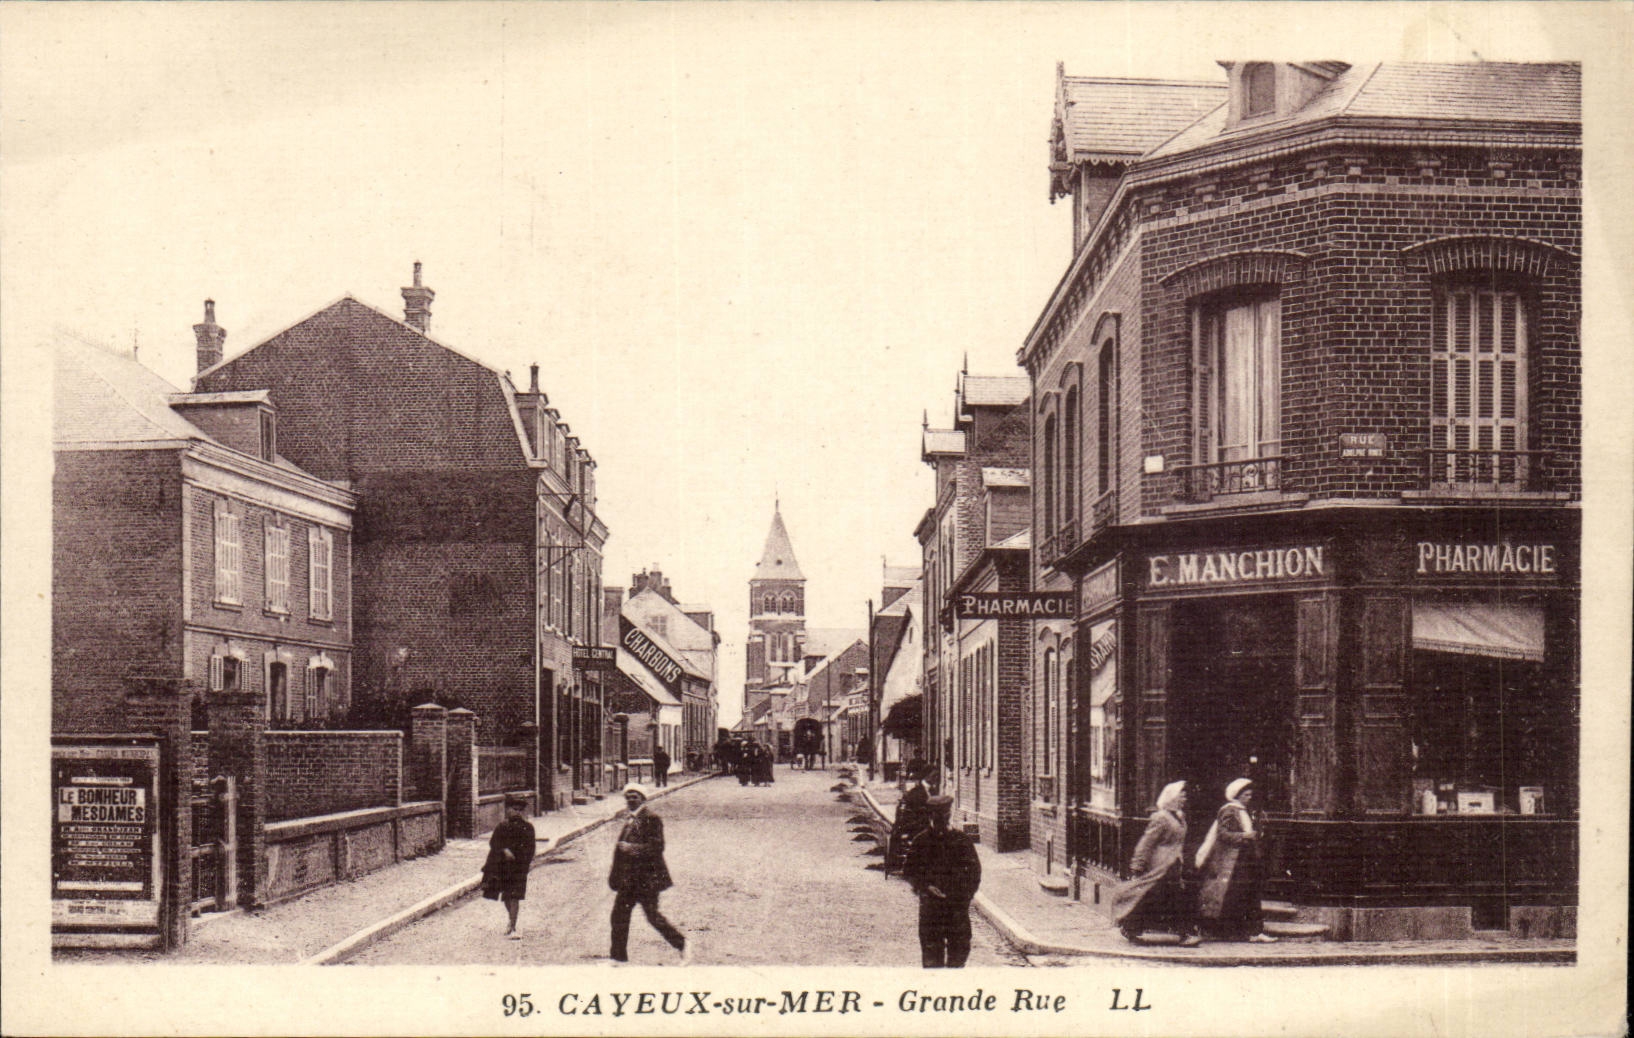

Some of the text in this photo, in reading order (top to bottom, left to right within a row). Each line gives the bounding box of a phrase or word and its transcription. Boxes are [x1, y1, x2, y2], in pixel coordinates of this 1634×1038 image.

[1350, 435, 1374, 445] RUE
[1417, 542, 1556, 573] PHARMACIE
[961, 595, 1074, 615] PHARMACIE
[624, 627, 682, 684] CHARBONS
[60, 788, 137, 805] LE BONHEUR
[71, 805, 144, 821] MESDAMES
